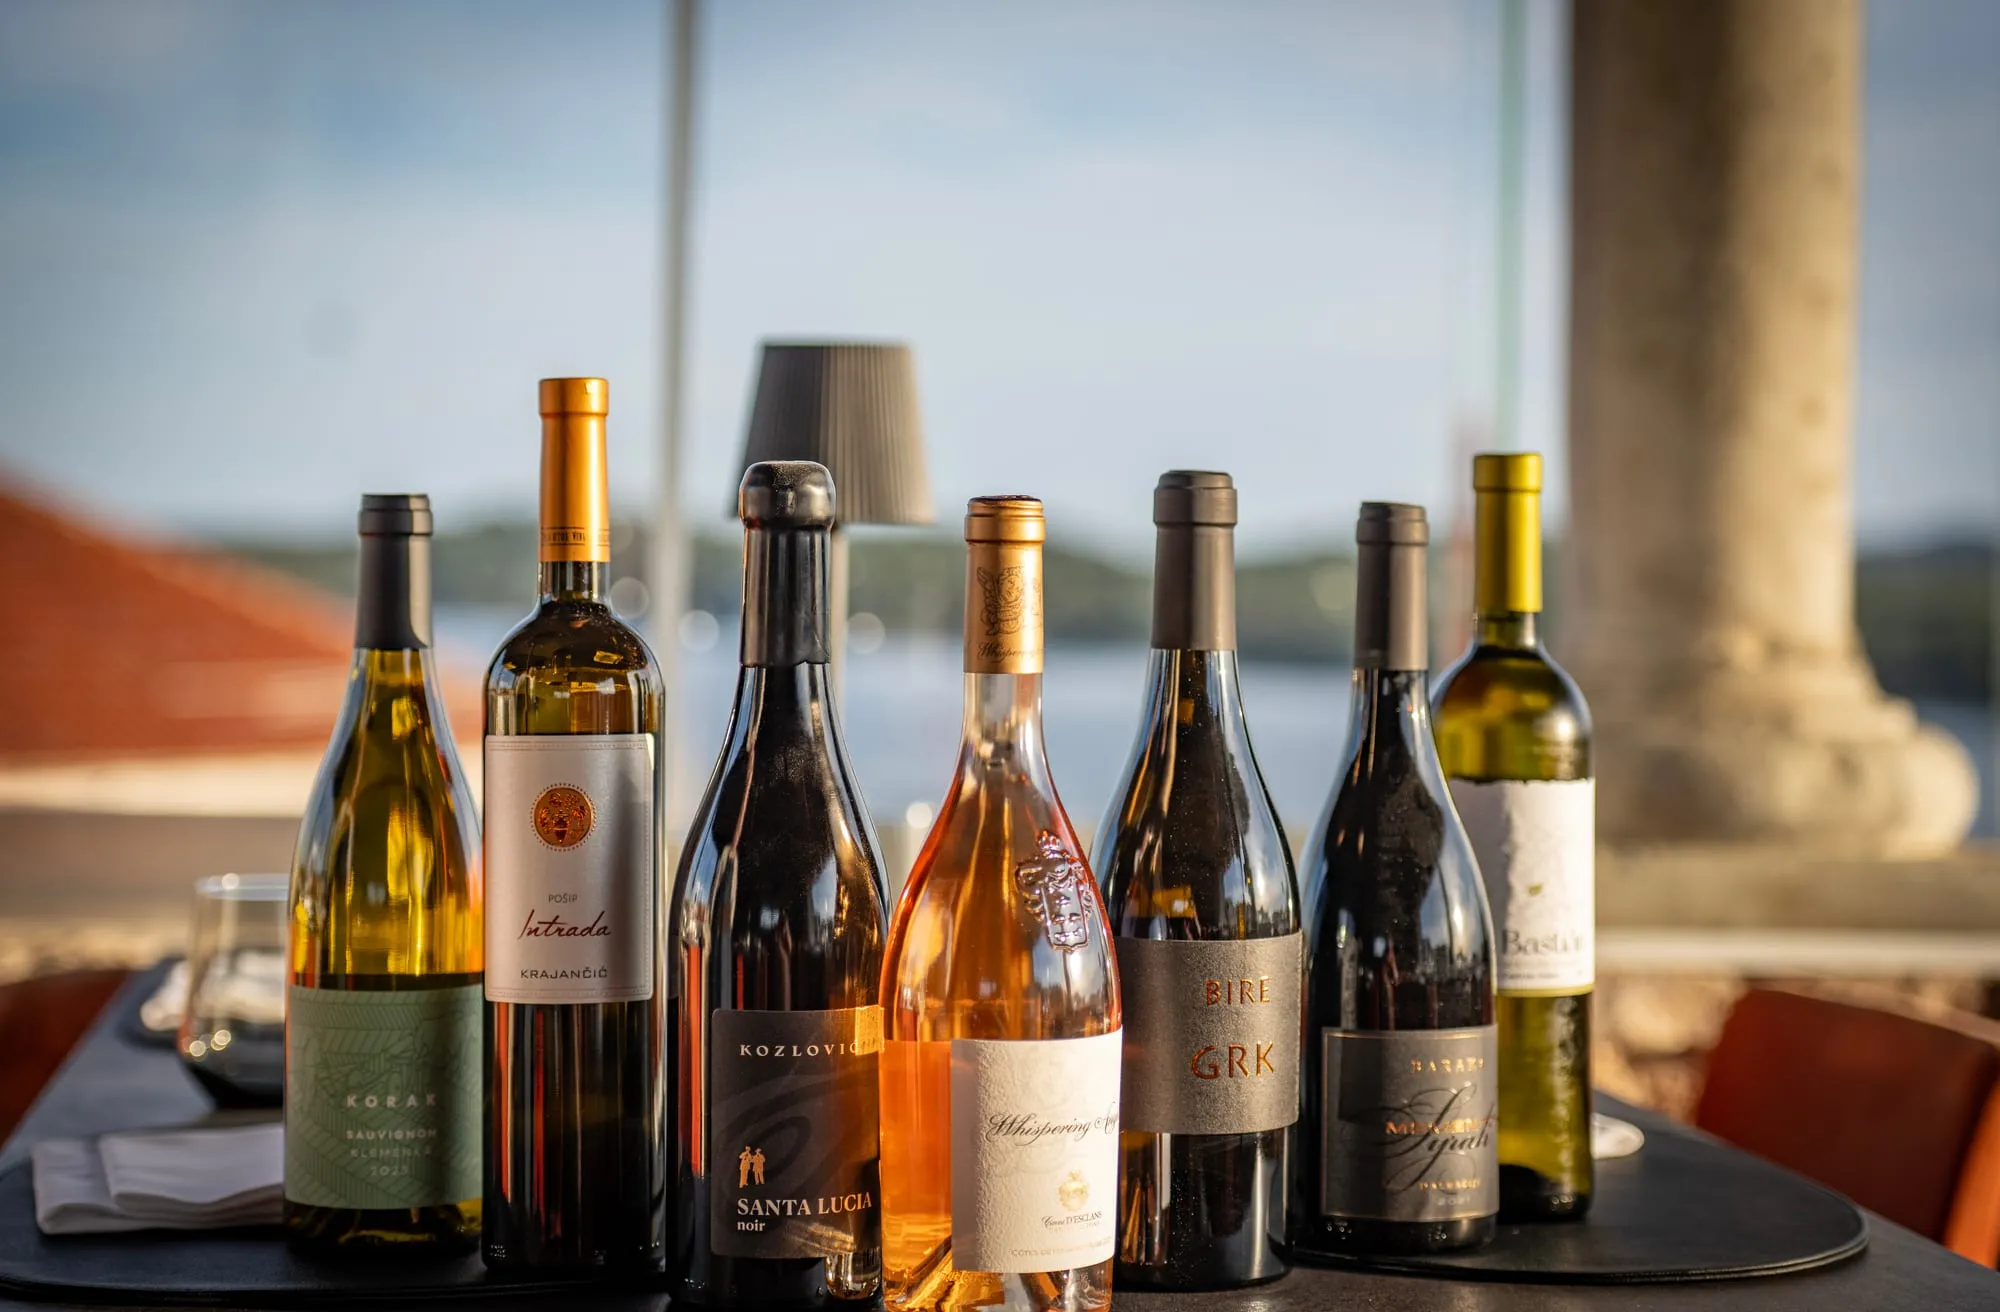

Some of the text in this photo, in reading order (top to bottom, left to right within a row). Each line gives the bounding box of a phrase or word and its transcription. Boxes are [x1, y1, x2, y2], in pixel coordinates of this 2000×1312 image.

[548, 893, 578, 904] POŠIP
[518, 909, 612, 940] Intrada
[520, 966, 608, 980] KRAJANČIĆ
[1191, 1041, 1274, 1080] GRK
[346, 1093, 437, 1108] KORAK
[346, 1129, 437, 1140] SAUVIGNON
[985, 1113, 1091, 1147] Whispering
[737, 1191, 873, 1216] SANTA LUCIA
[737, 1219, 766, 1232] noir
